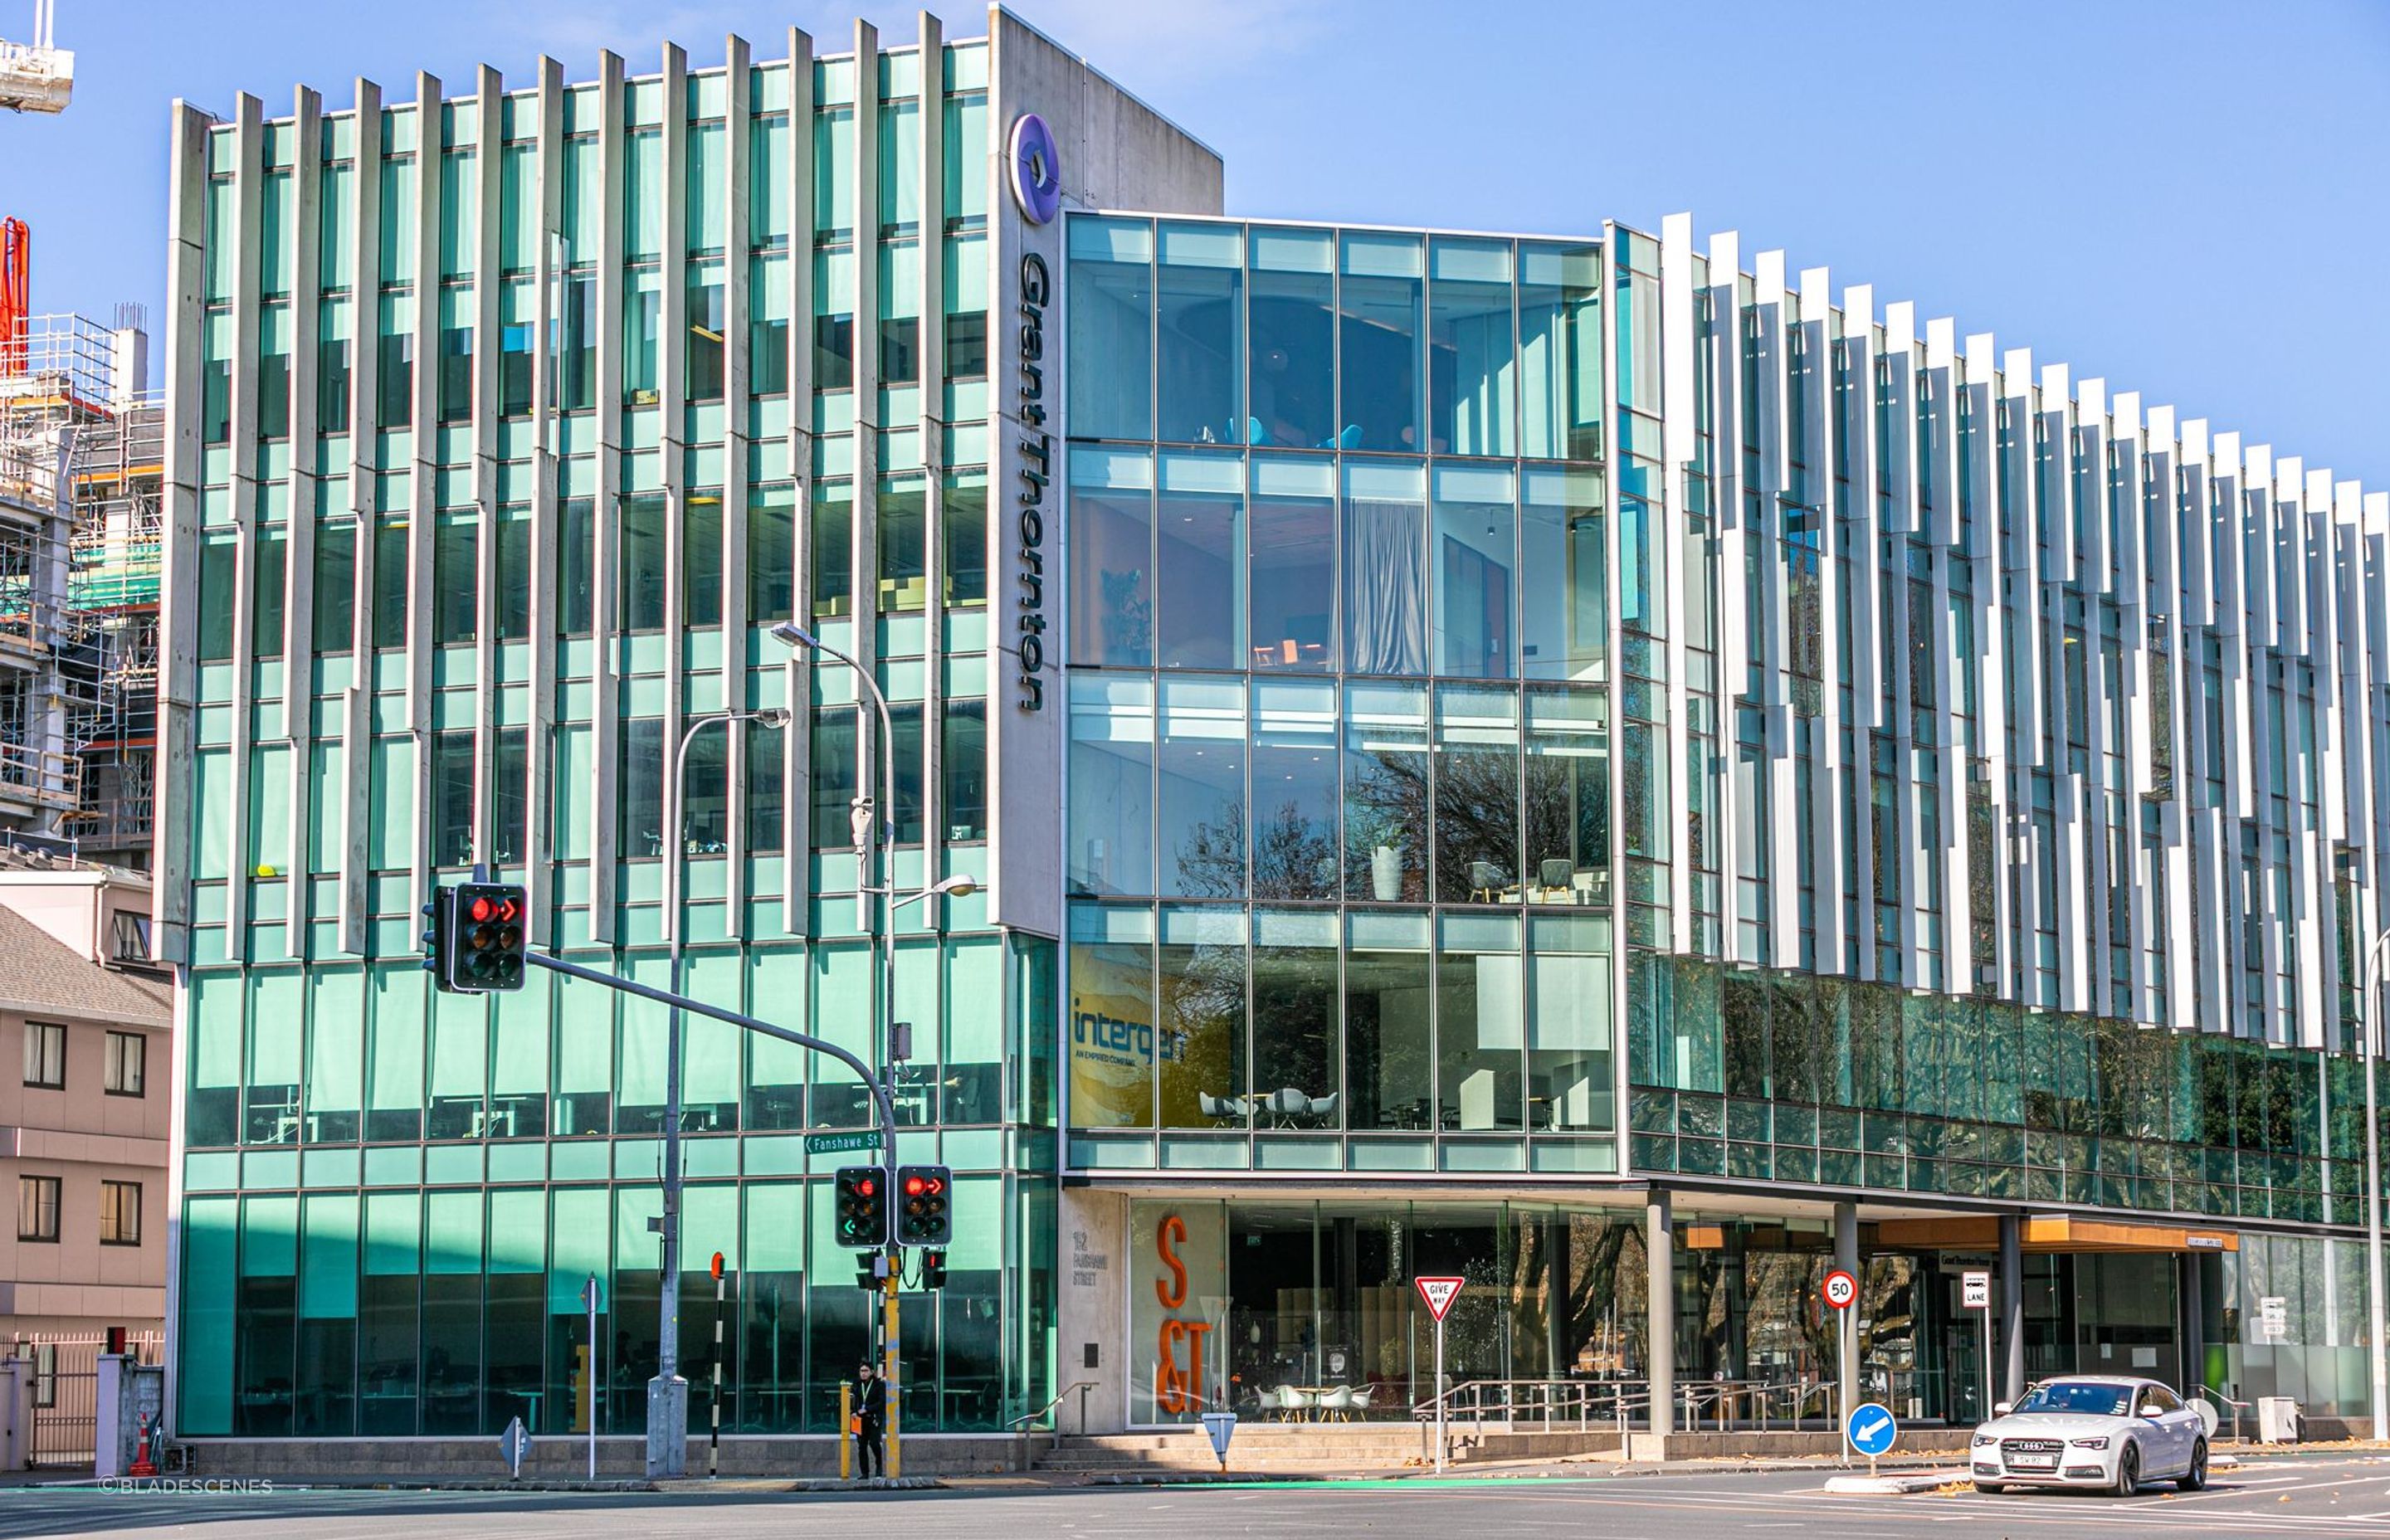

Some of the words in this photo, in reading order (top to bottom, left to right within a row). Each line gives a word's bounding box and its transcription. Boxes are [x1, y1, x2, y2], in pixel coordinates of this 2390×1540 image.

[1022, 252, 1051, 426] Grant
[1021, 436, 1051, 712] Thornton
[814, 1136, 861, 1151] Fanshawe
[867, 1133, 878, 1146] St
[1156, 1216, 1187, 1309] S
[1430, 1284, 1449, 1294] GIVE
[1832, 1283, 1849, 1296] 50
[1967, 1294, 1985, 1302] LANE
